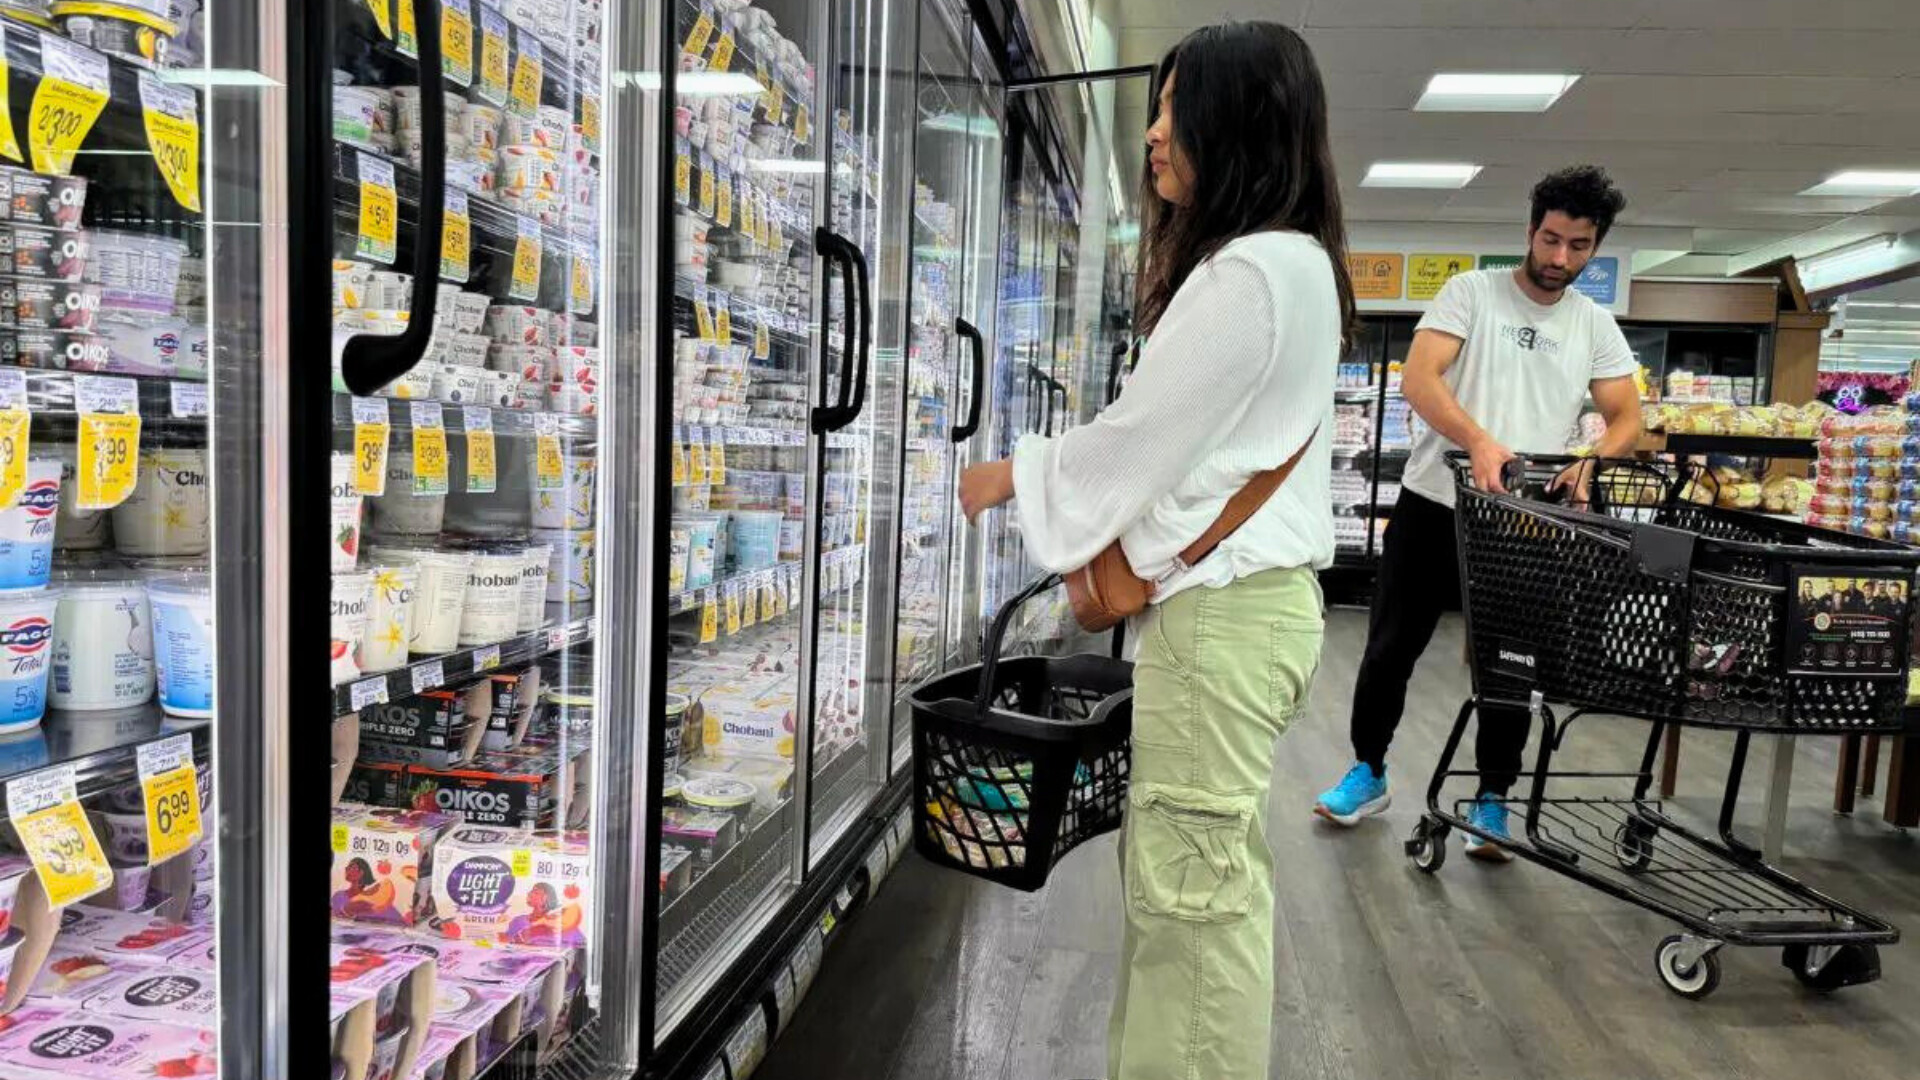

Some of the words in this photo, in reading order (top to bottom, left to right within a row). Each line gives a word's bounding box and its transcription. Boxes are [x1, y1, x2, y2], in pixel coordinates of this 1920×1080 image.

[9, 655, 43, 675] Total
[388, 725, 415, 737] ZERO
[723, 722, 774, 738] Chobani
[435, 787, 511, 813] OIKOS
[157, 790, 190, 833] 699
[477, 812, 505, 822] ZERO
[353, 836, 367, 850] 80
[537, 861, 553, 875] 80
[561, 863, 580, 877] 12g
[459, 872, 508, 892] LIGHT
[472, 890, 499, 906] FIT
